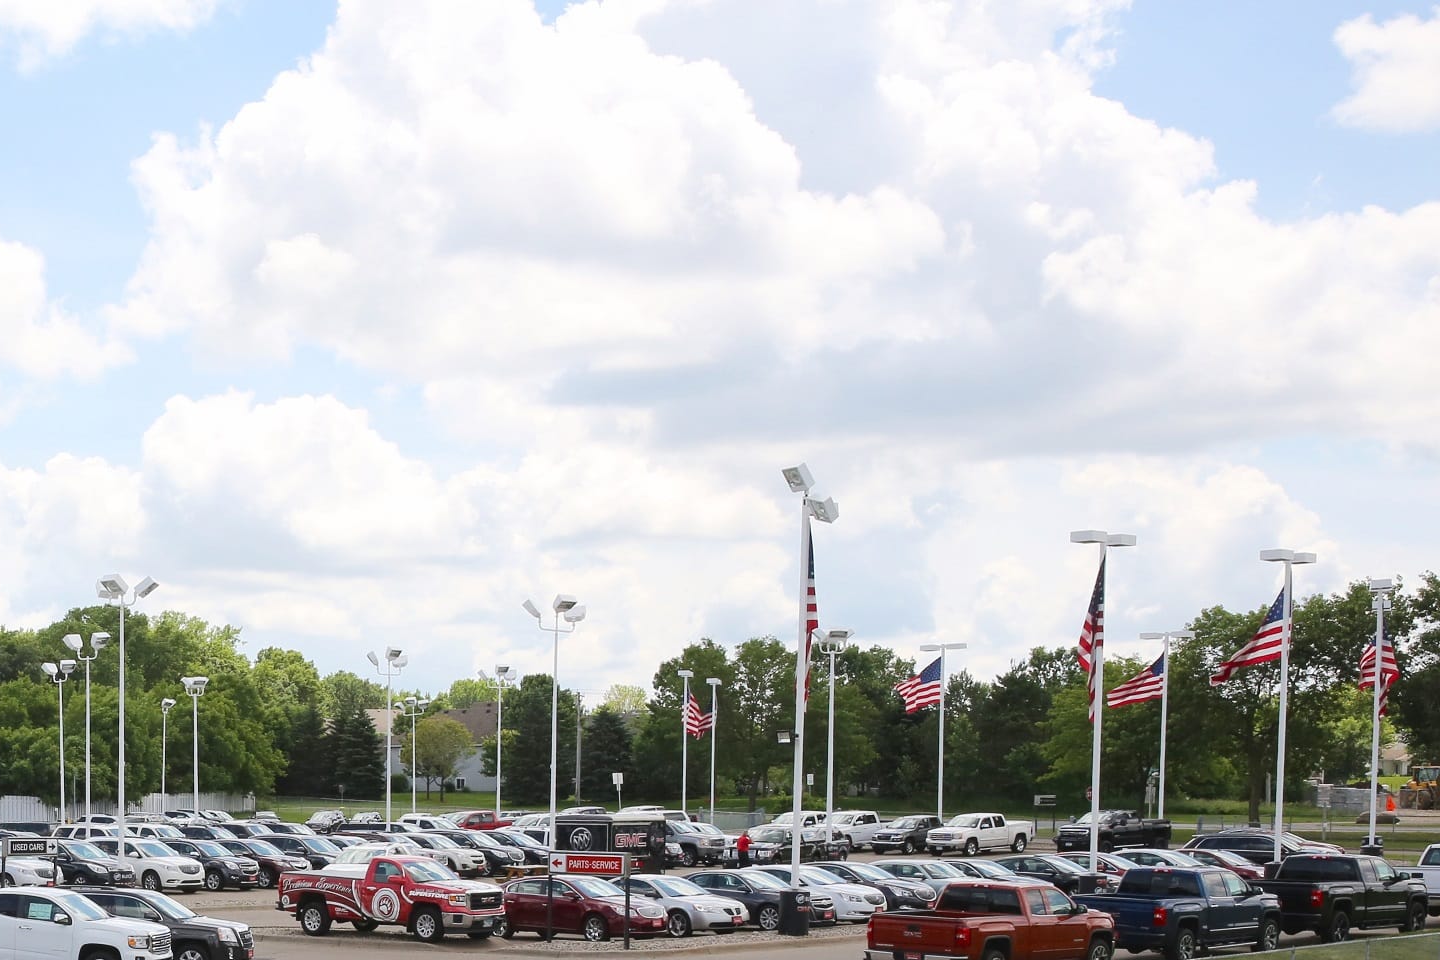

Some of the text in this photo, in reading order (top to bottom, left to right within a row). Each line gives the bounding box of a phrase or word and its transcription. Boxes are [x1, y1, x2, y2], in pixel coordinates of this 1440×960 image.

[615, 833, 647, 848] GMC
[12, 843, 45, 851] USED CARS
[568, 859, 620, 870] PARTS-SERVICE
[283, 877, 351, 894] Premium Experience
[408, 890, 449, 900] SUPERSTORE
